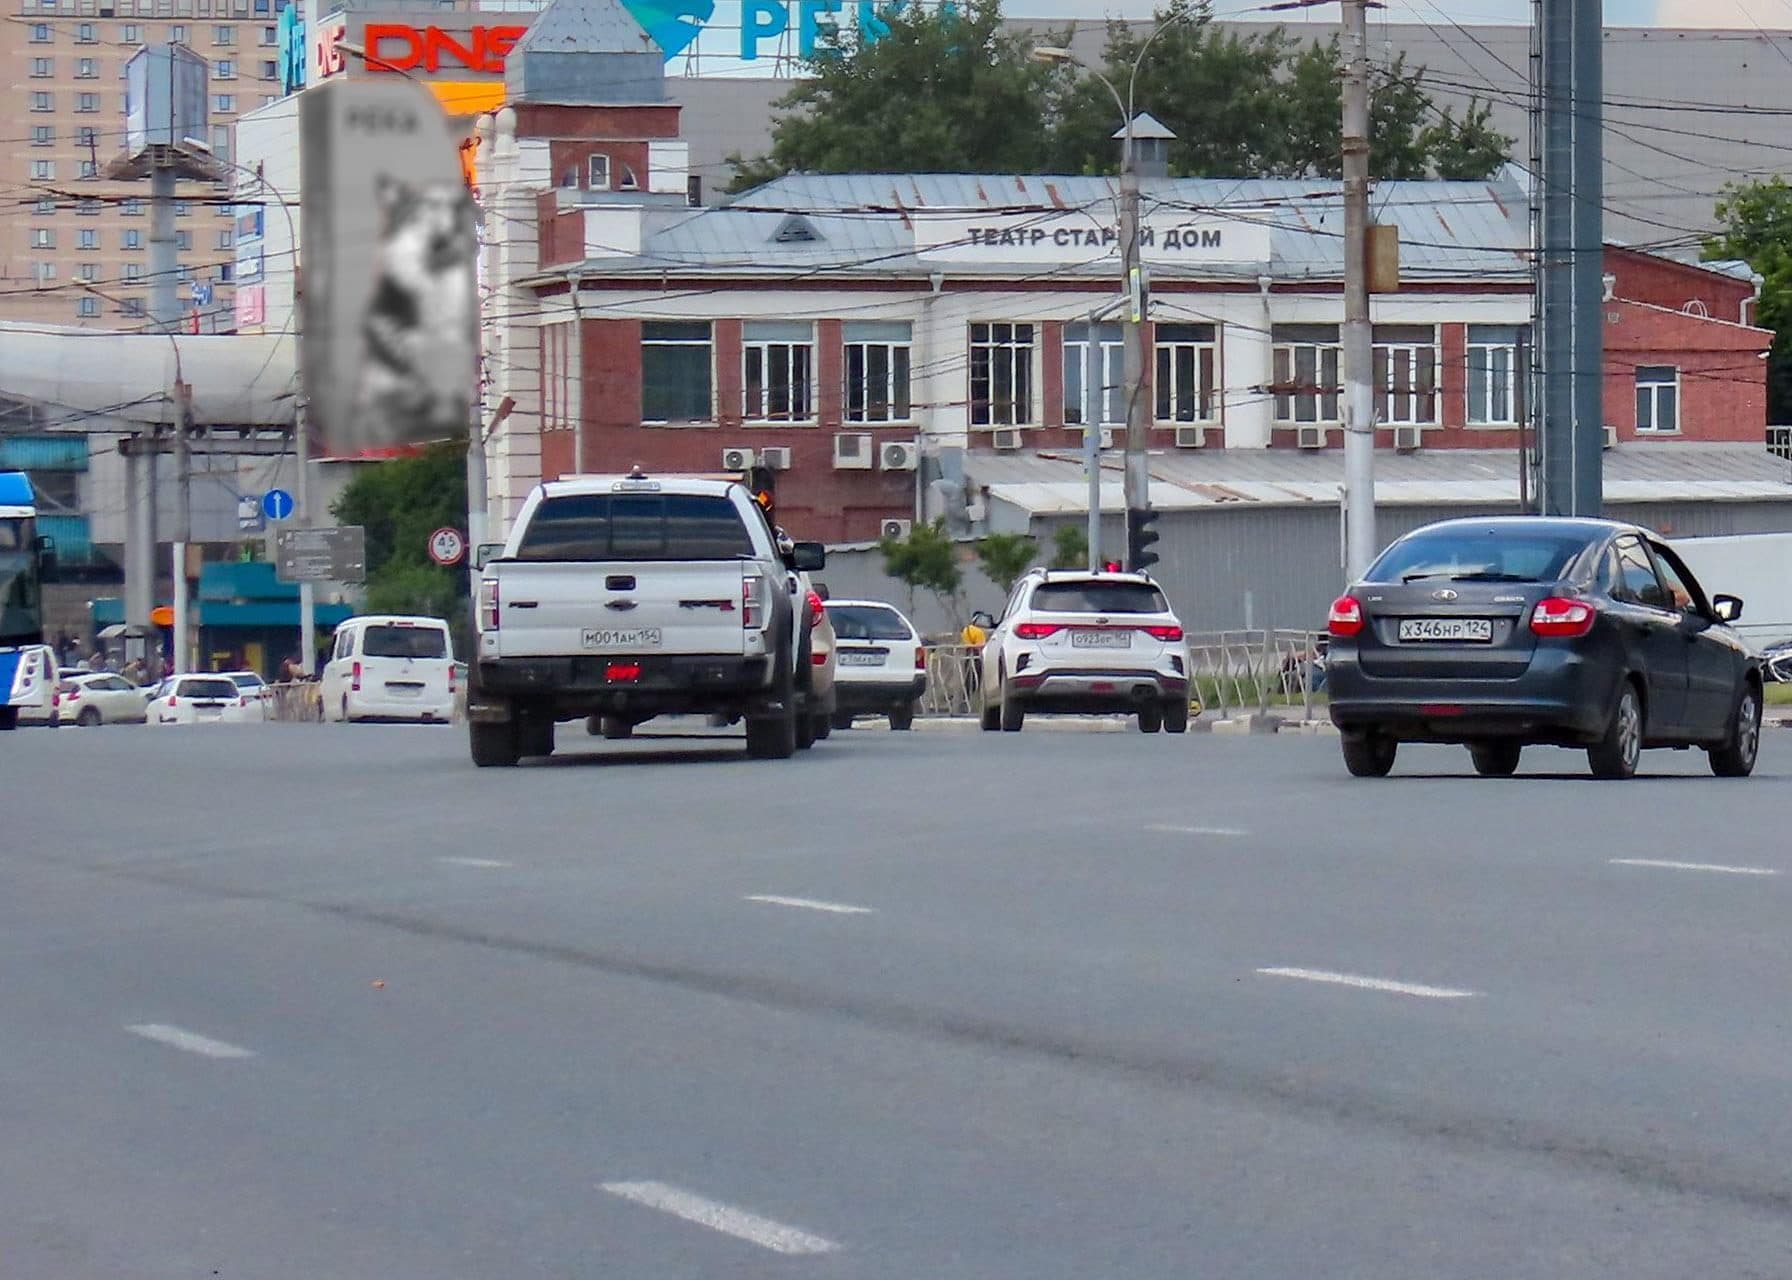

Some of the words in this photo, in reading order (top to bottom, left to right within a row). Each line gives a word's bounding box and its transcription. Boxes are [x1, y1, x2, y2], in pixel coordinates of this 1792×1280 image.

[365, 24, 528, 74] DNS
[967, 228, 1045, 247] ТЕАТР
[1053, 227, 1155, 247] СТАРЙ
[1163, 229, 1221, 250] ДОМ
